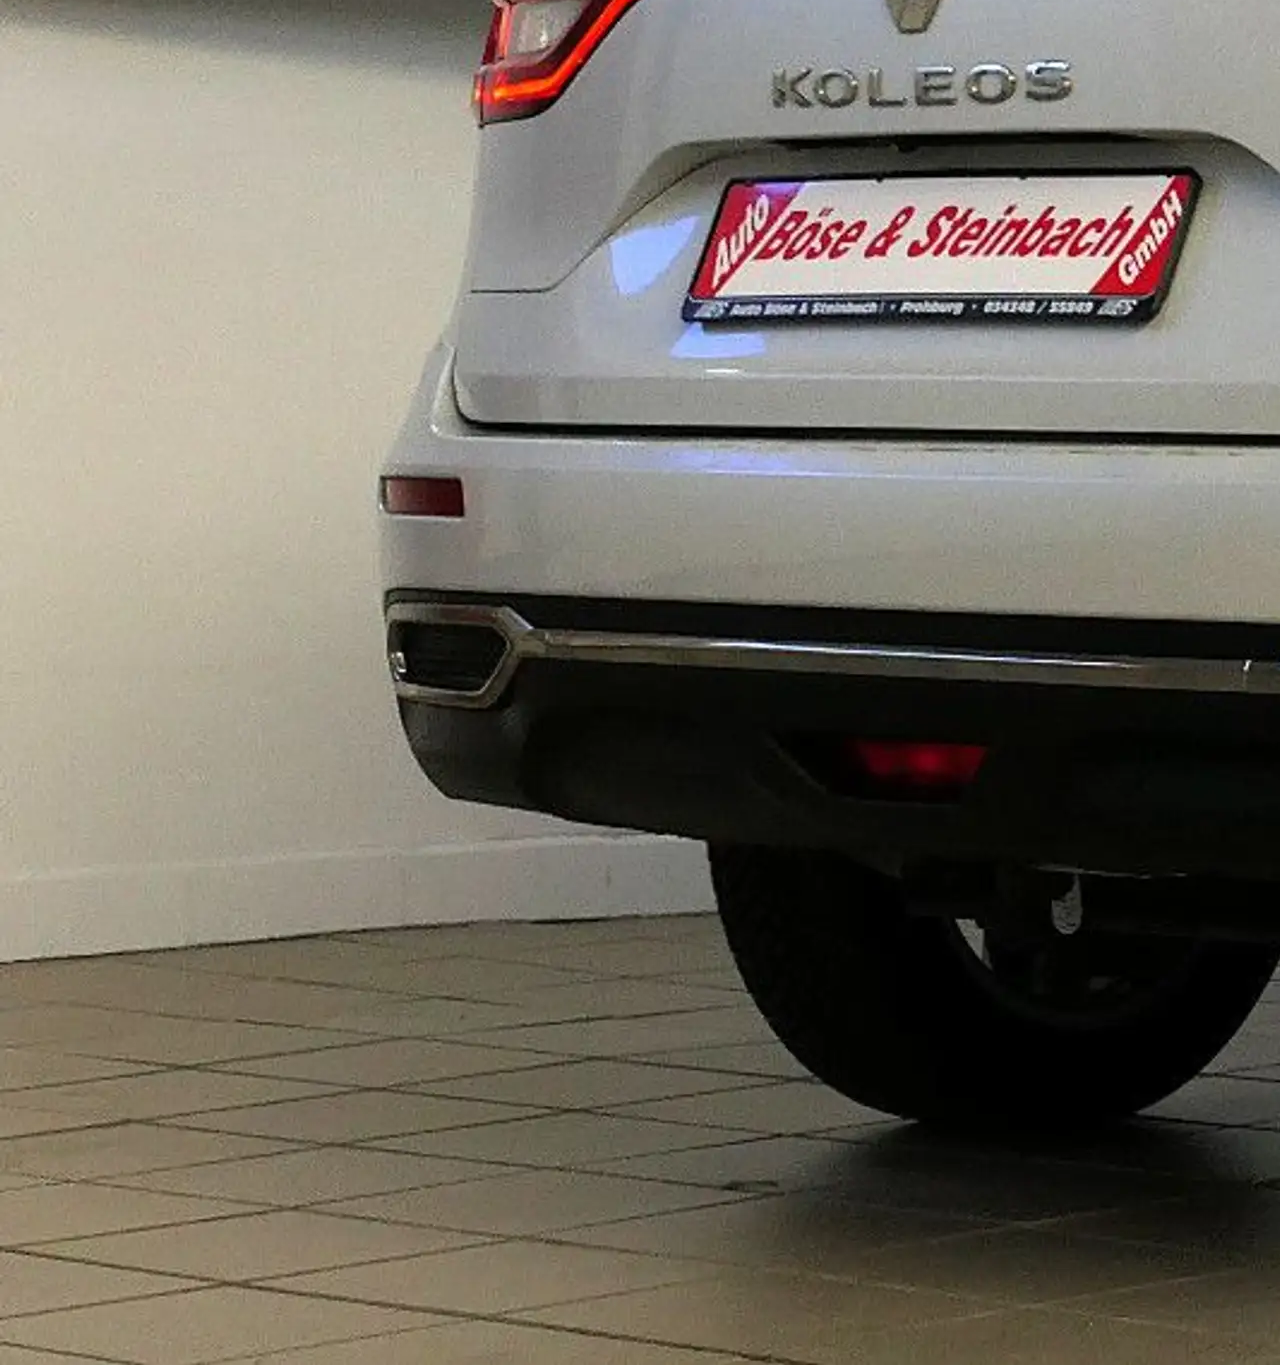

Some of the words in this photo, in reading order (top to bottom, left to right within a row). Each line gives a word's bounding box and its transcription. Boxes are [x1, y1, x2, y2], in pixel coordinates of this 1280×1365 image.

[771, 59, 1074, 110] KOLEOS
[712, 193, 771, 288] Auto
[753, 206, 859, 261] Böse
[864, 205, 914, 259] &
[907, 204, 1135, 259] Steinbach
[1117, 190, 1184, 285] GmbH
